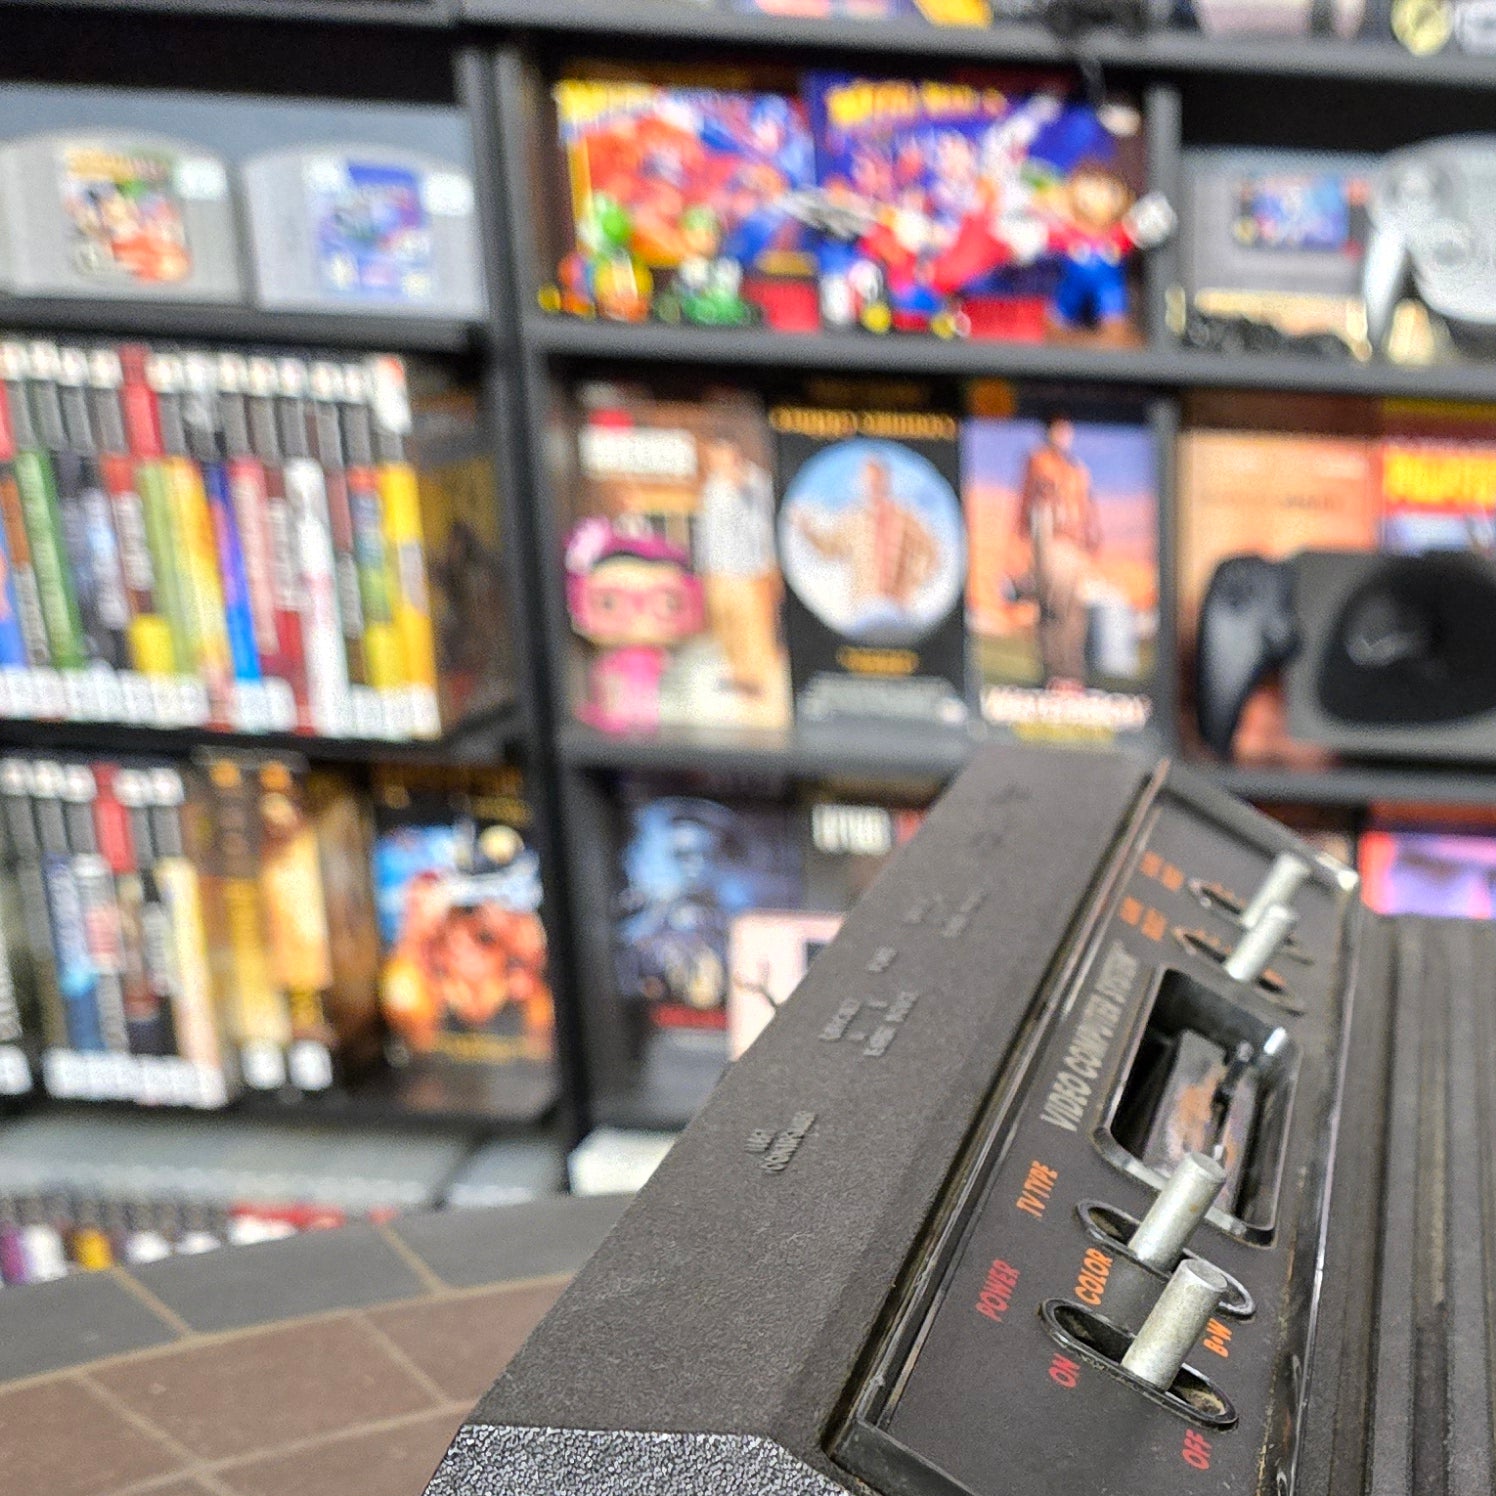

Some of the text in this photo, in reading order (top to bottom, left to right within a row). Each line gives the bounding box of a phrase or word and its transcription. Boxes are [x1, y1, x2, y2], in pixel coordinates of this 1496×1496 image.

[1041, 1071, 1092, 1131] VIDEO
[1016, 1160, 1058, 1218] TV TYPE
[976, 1259, 1020, 1321] POWER
[1075, 1247, 1113, 1305] COLOR
[1049, 1353, 1080, 1388] ON
[1182, 1429, 1211, 1470] OFF
